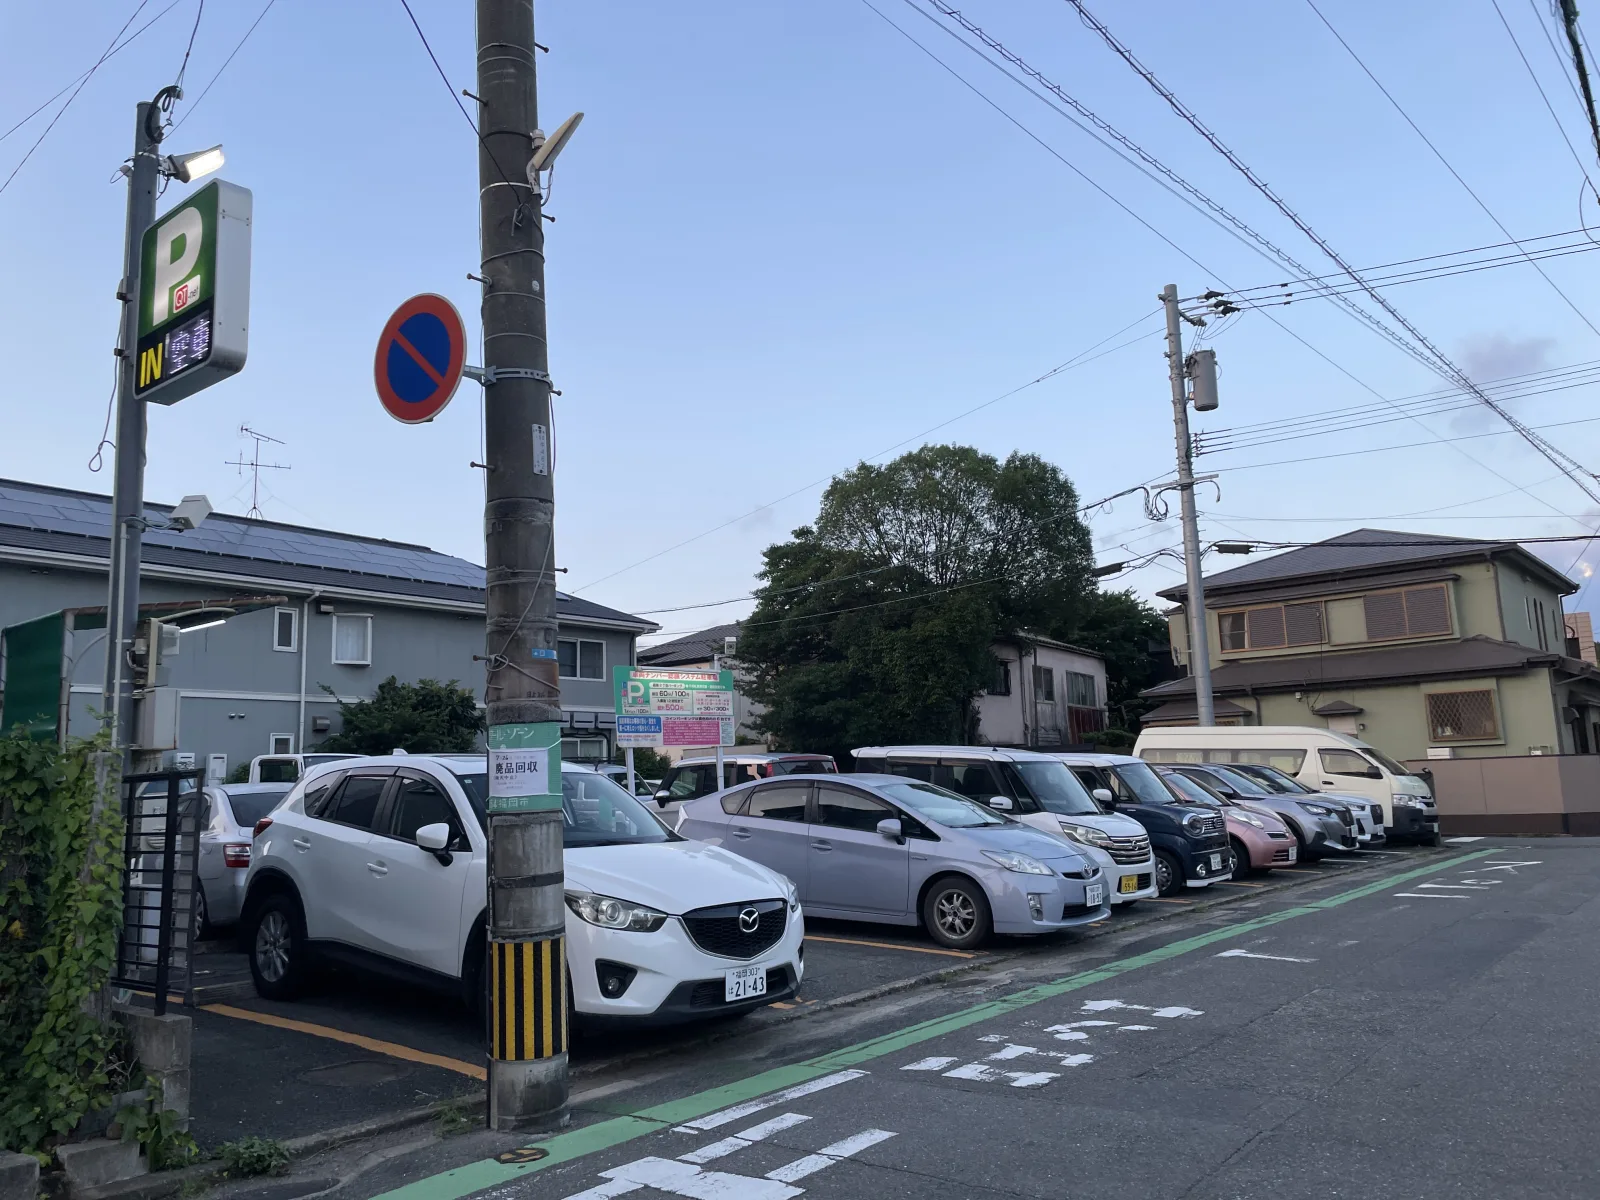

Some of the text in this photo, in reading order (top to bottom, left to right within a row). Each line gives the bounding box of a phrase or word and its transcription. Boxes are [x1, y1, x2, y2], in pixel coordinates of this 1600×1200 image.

[152, 206, 203, 327] P
[169, 318, 211, 374] 空車
[140, 343, 163, 388] IN
[627, 681, 645, 704] P
[495, 761, 538, 774] 廃品回収
[747, 967, 758, 976] 303
